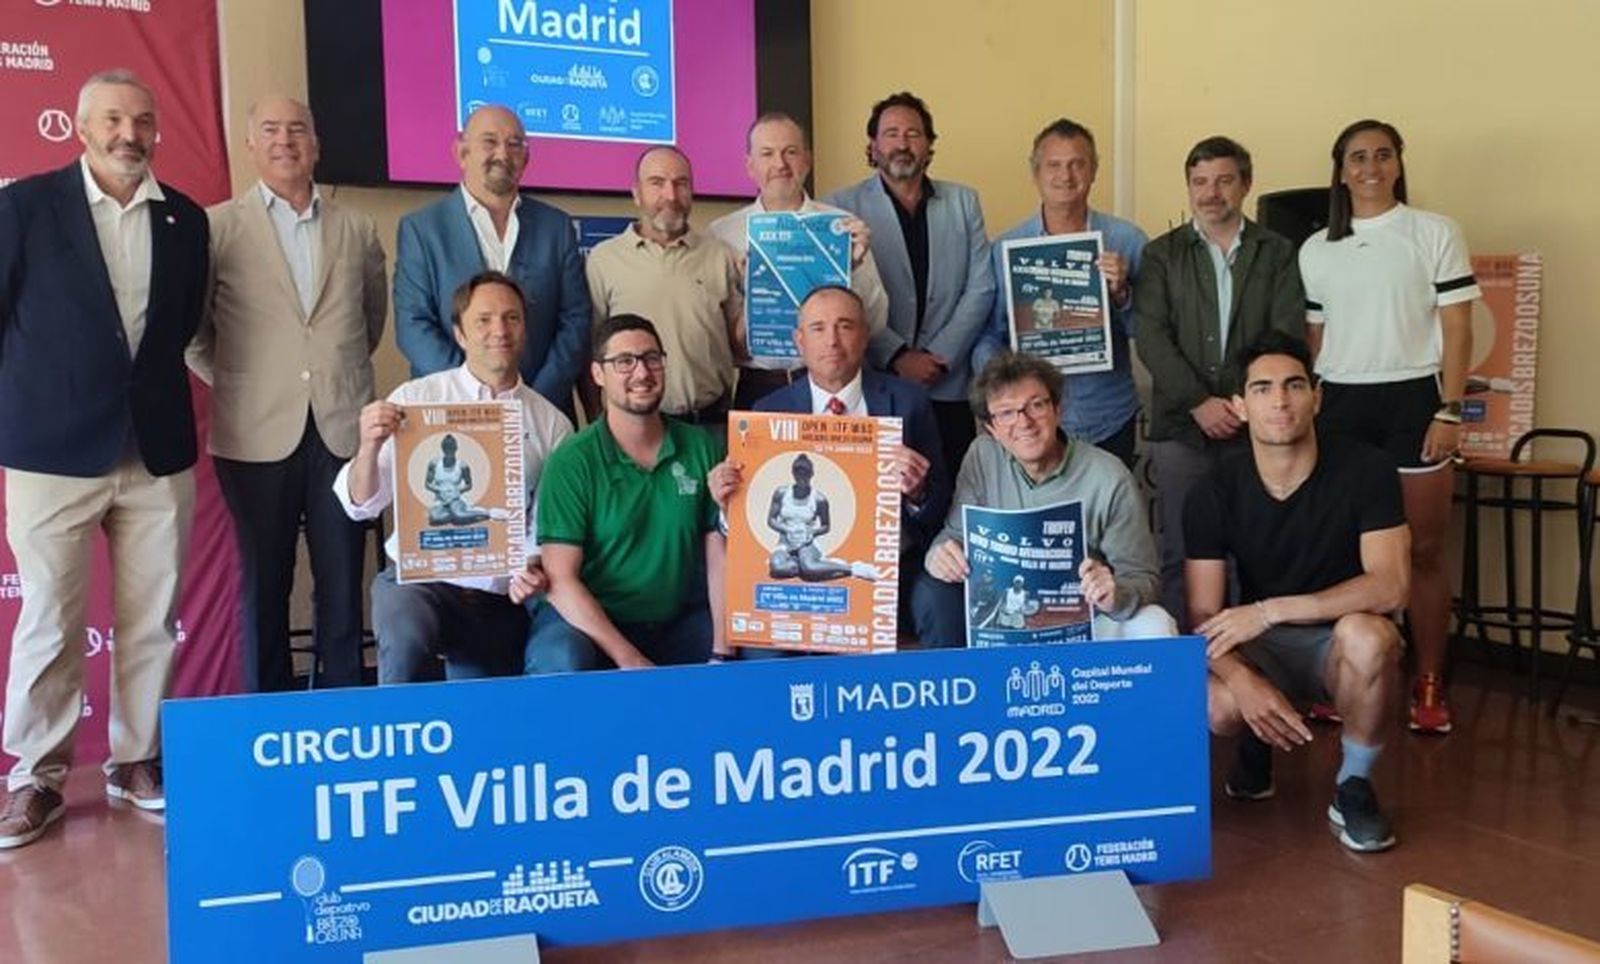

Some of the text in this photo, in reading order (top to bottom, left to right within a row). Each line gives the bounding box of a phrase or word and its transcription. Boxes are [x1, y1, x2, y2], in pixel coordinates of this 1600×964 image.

[498, 0, 642, 46] Madrid
[0, 41, 49, 56] RACIÓN
[6, 57, 54, 71] MADRID
[768, 418, 799, 441] VIII
[503, 401, 526, 577] RCADISBREZOOSUNA
[977, 525, 1074, 547] VOLVO
[1111, 663, 1153, 675] Mundial
[837, 677, 977, 713] MADRID
[1072, 693, 1100, 705] 2022
[252, 720, 453, 767] CIRCUITO
[315, 724, 1100, 842] ITF Villa de Madrid 2022
[1096, 837, 1155, 855] FEDERACIÓN
[976, 850, 1022, 871] RFET
[1121, 850, 1158, 865] MADRID
[848, 859, 895, 889] ITF
[314, 892, 342, 904] club
[407, 900, 490, 925] CIUDAD
[503, 888, 600, 915] RAQUETA
